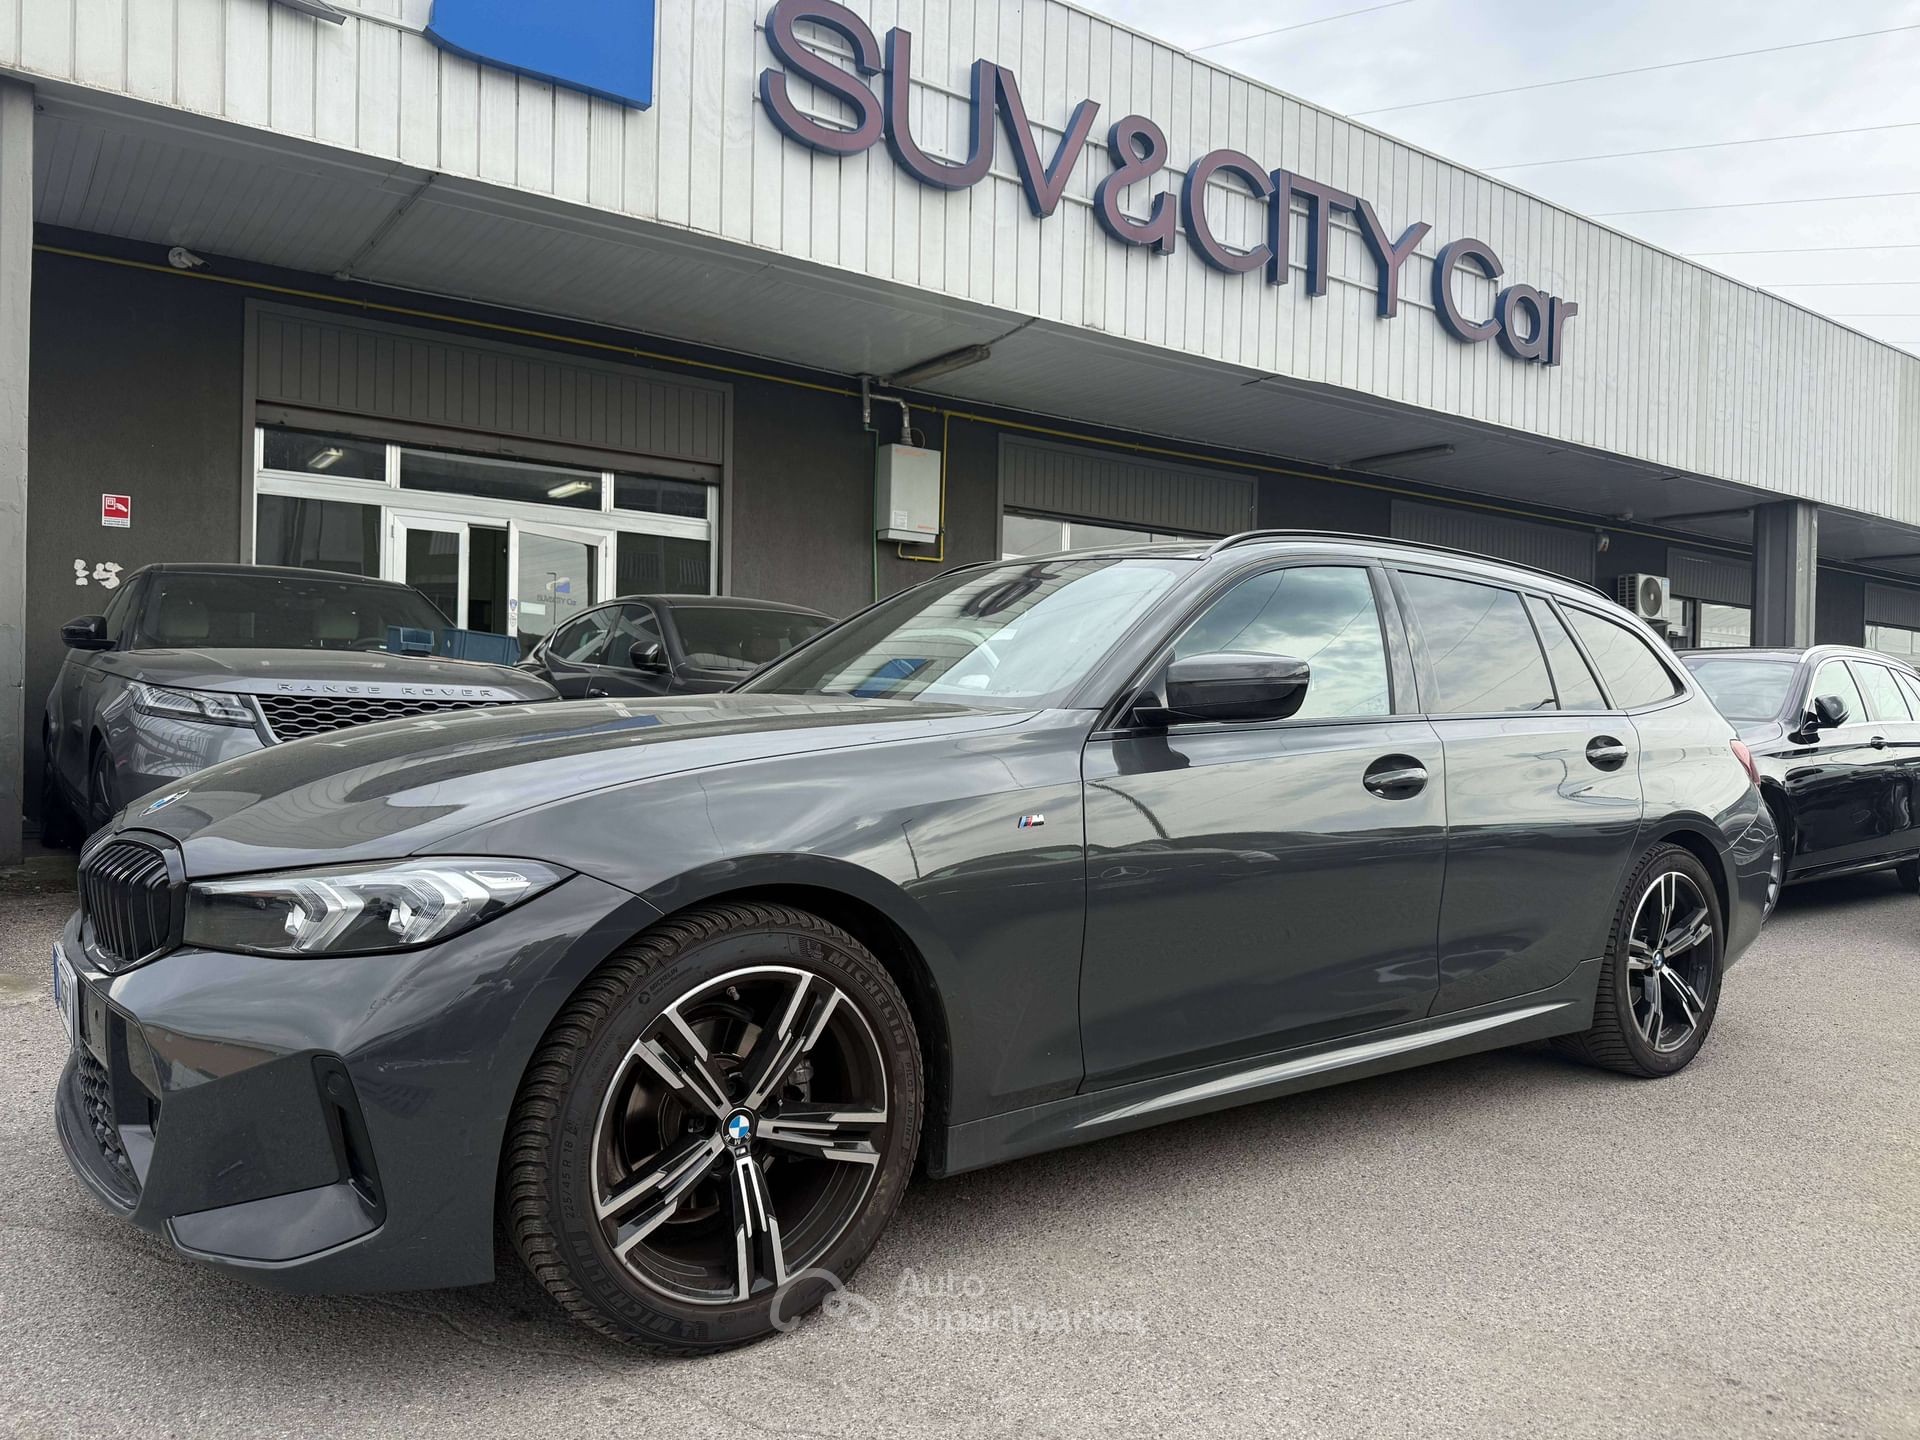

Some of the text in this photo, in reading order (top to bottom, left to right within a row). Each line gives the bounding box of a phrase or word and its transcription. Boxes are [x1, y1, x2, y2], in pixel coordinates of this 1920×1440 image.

[1433, 237, 1578, 368] Car
[277, 682, 494, 698] RANGE ROVER
[827, 950, 905, 1046] MICHELIN
[904, 1061, 914, 1095] PILOT
[561, 1159, 573, 1168] R
[562, 1140, 575, 1155] 18
[561, 1171, 575, 1219] 225/45
[573, 1239, 677, 1334] MICHELIN
